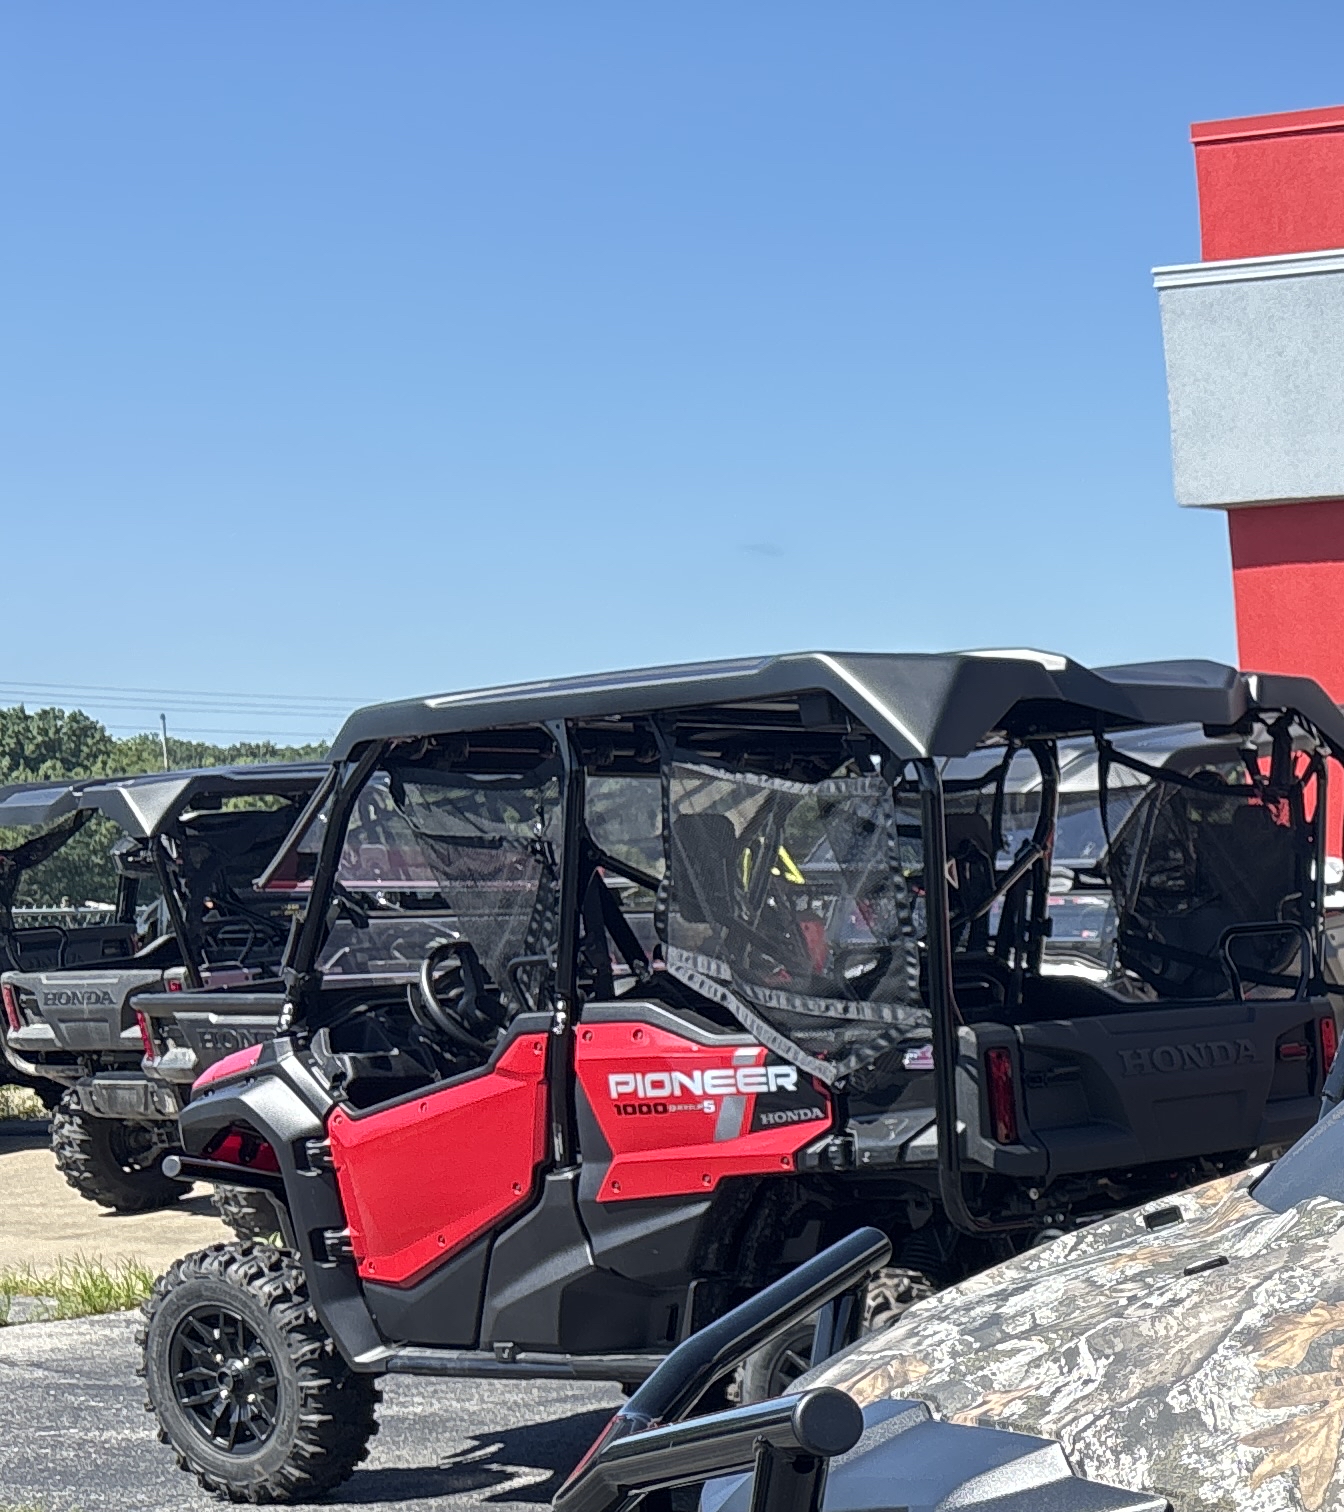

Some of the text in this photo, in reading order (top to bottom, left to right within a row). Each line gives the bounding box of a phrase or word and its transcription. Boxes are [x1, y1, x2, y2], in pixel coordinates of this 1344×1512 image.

[43, 991, 117, 1006] HONDA
[197, 1029, 277, 1049] HON
[1118, 1039, 1259, 1076] HONDA
[608, 1065, 798, 1099] PIONEER
[614, 1102, 668, 1115] 1000
[759, 1108, 825, 1125] HONDA
